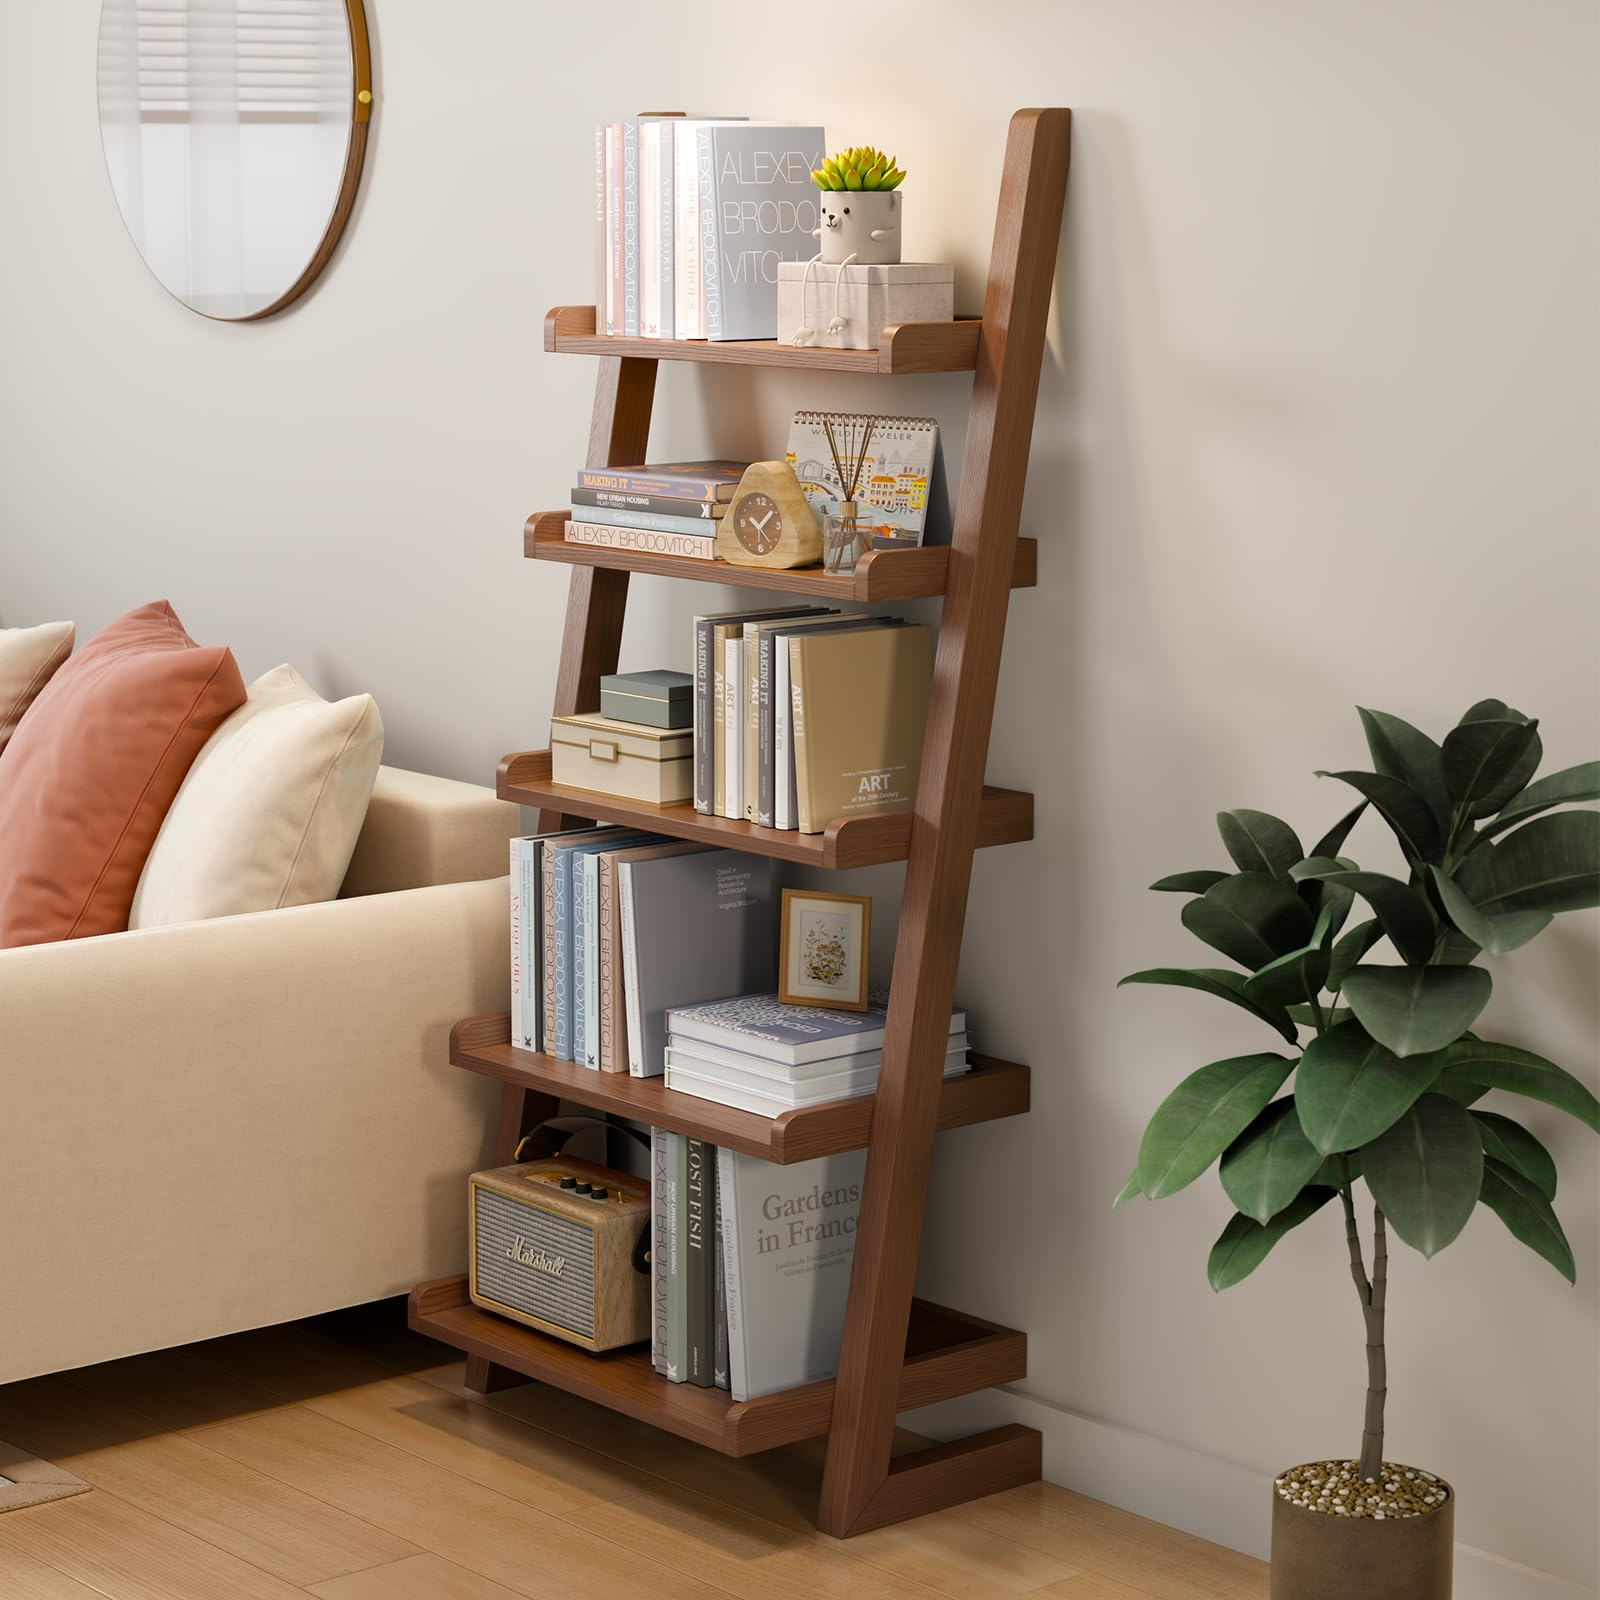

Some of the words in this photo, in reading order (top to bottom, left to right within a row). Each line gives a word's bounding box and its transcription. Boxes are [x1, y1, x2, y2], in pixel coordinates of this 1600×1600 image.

[624, 121, 635, 195] ALEXEY
[698, 132, 713, 202] ALEXEY
[720, 151, 819, 185] ALEXEY
[624, 201, 636, 322] BRODOVITCH
[703, 209, 720, 328] BRODOVITCH
[583, 474, 617, 488] MAKING
[618, 478, 628, 489] IT
[597, 493, 608, 501] NEW
[609, 495, 626, 503] URBAN
[627, 496, 650, 506] HOUSING
[756, 497, 767, 506] 12
[567, 525, 618, 545] ALEXEY
[619, 530, 703, 556] BRODOVITCH
[740, 518, 746, 528] 9
[775, 521, 781, 531] 3
[757, 543, 764, 553] 6
[698, 631, 706, 679] MAKING
[760, 639, 769, 689] MAKING
[698, 681, 706, 695] IT
[715, 671, 724, 703] ART
[727, 682, 736, 712] ART
[760, 691, 769, 704] IT
[792, 683, 804, 715] ART
[858, 774, 891, 793] ART
[545, 847, 554, 919] ALEXEY
[601, 859, 610, 933] ALEXEY
[546, 924, 556, 1043] BRODOVITCH
[601, 938, 611, 1059] BRODOVITCH
[689, 1140, 702, 1198] LOST
[762, 1184, 860, 1221] Gardens
[689, 1200, 702, 1249] FISH
[758, 1228, 781, 1255] in
[787, 1216, 859, 1248] Franc
[507, 1235, 565, 1276] Marshall
[725, 1218, 735, 1271] Gardens
[656, 1214, 667, 1359] BRODOVITCH
[728, 1272, 736, 1285] in
[728, 1288, 737, 1331] France
